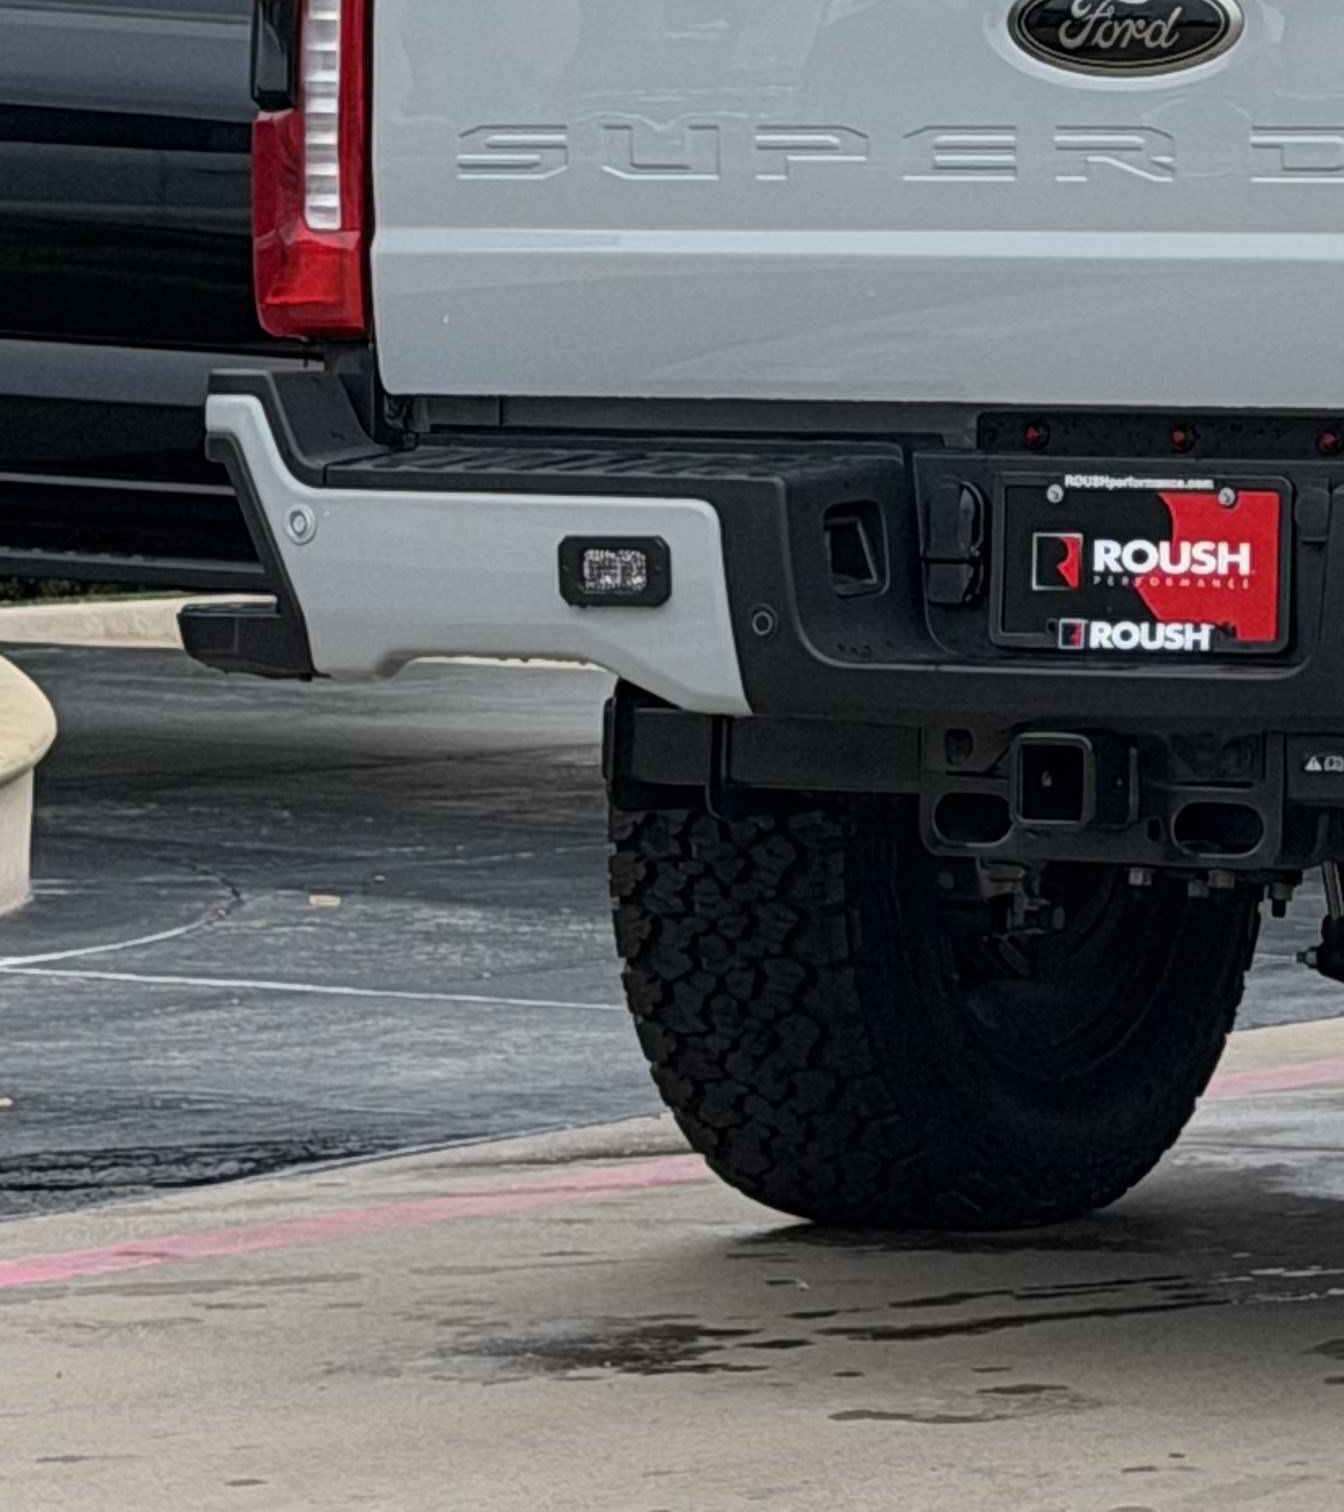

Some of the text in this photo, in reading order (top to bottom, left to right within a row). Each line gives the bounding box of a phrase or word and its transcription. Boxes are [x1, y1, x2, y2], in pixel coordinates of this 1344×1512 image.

[456, 124, 1176, 182] SUPER
[1092, 539, 1251, 576] ROUSH
[1088, 620, 1213, 651] ROUSH
